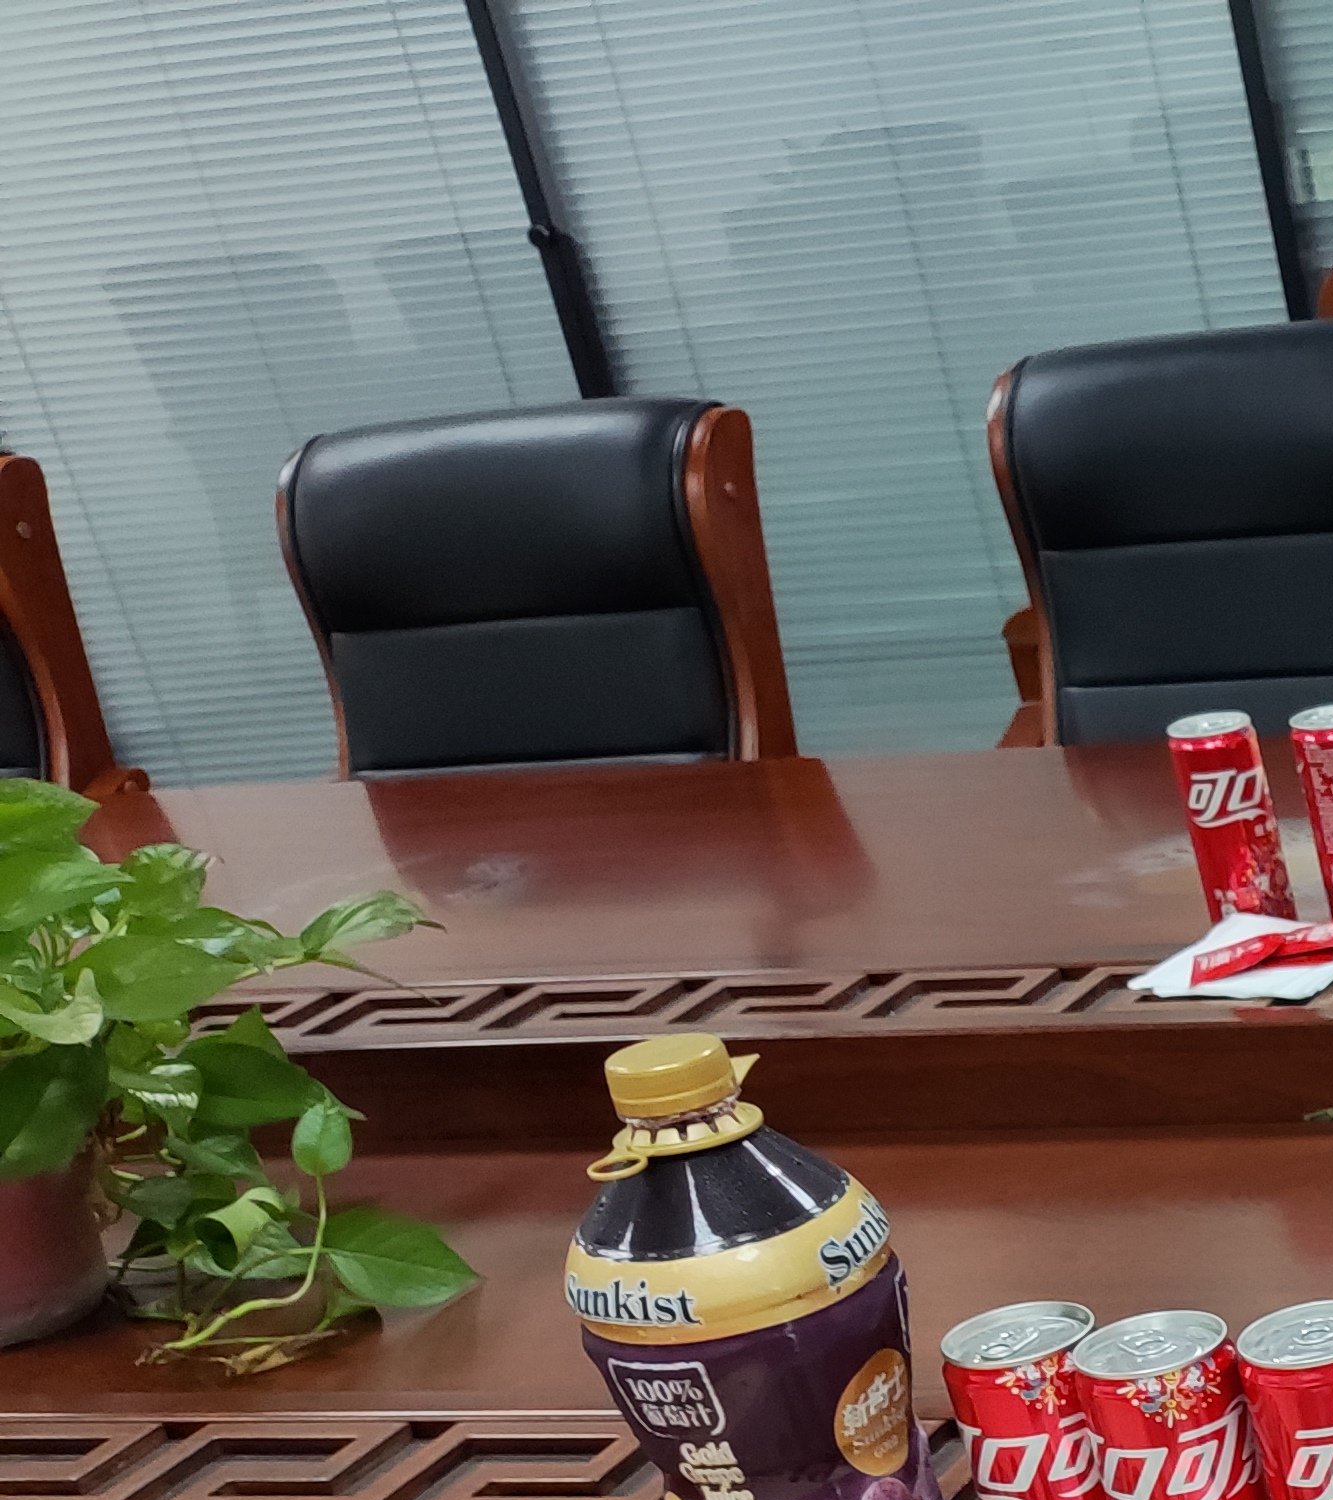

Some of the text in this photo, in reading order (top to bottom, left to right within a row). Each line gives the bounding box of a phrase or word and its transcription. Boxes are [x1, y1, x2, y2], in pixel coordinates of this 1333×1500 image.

[819, 1193, 890, 1286] Sunk
[566, 1274, 703, 1326] Sunkist
[625, 1377, 705, 1403] 100%
